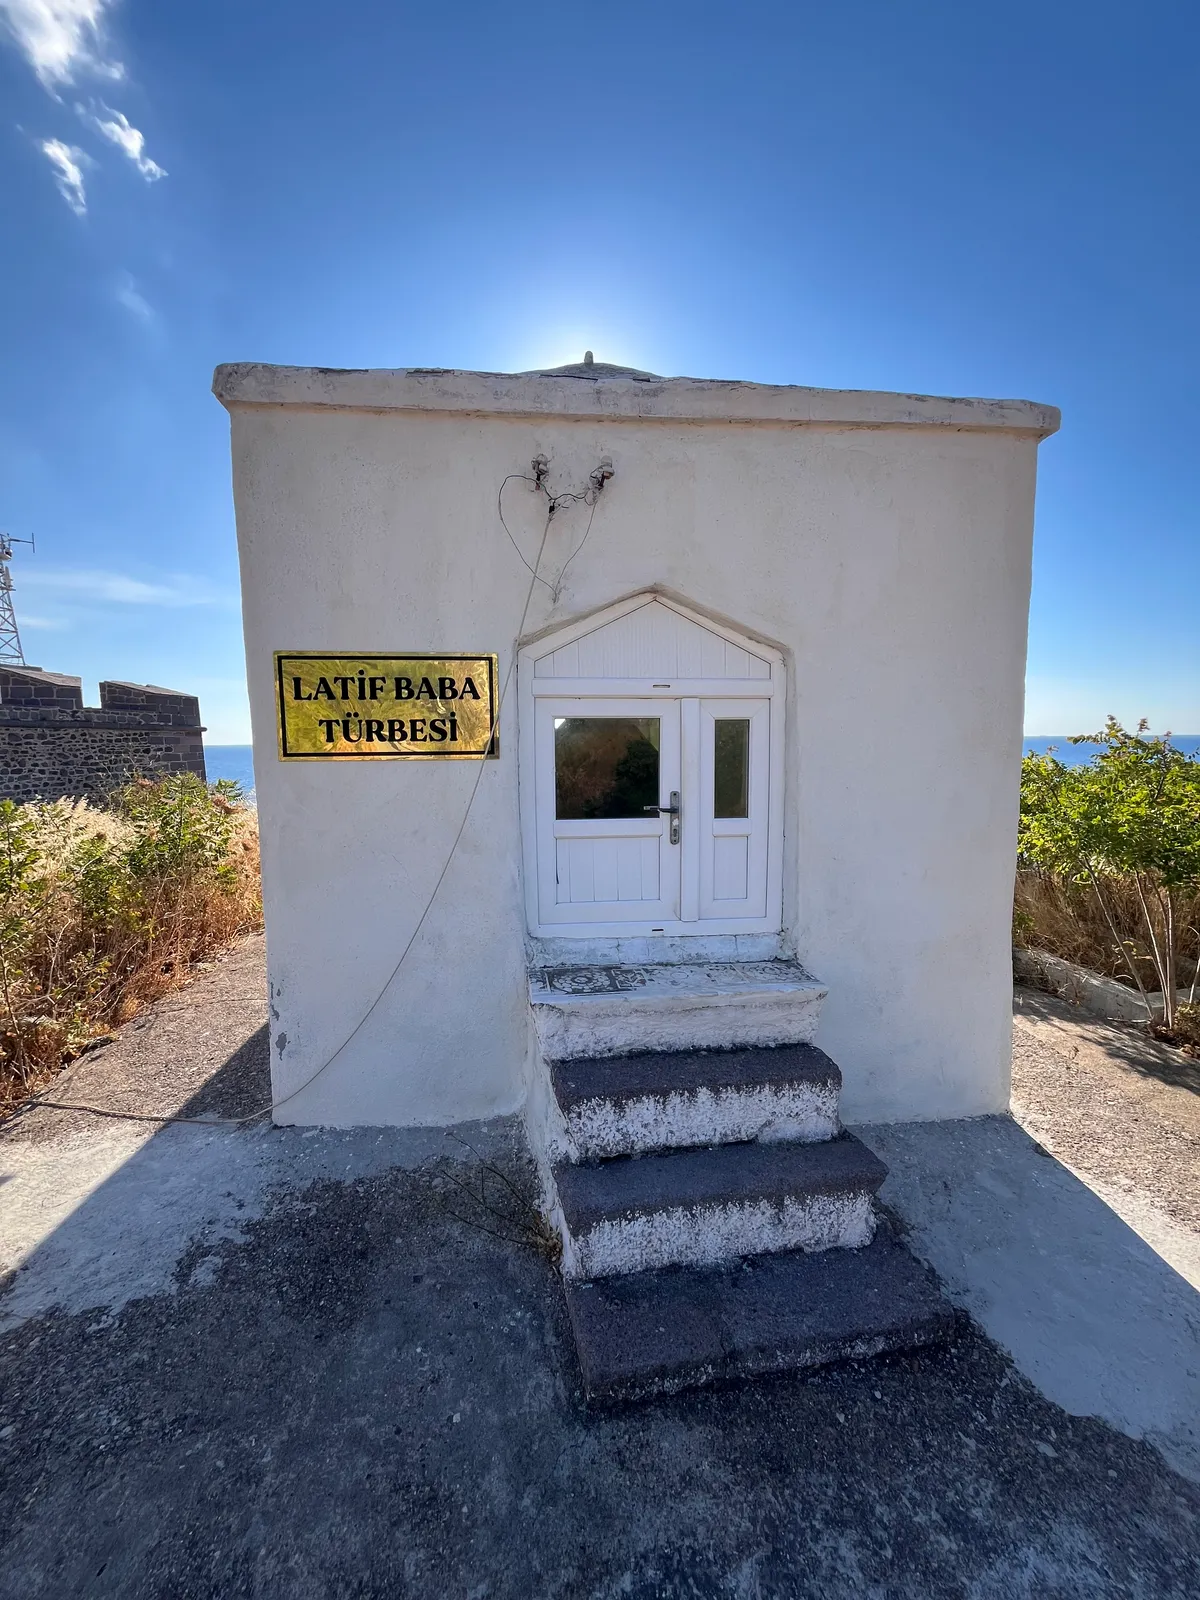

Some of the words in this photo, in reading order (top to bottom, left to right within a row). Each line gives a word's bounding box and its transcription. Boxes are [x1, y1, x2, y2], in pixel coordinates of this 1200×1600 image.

[292, 669, 386, 701] LATİF
[394, 676, 480, 701] BABA
[318, 711, 459, 743] TÜRBESİ
